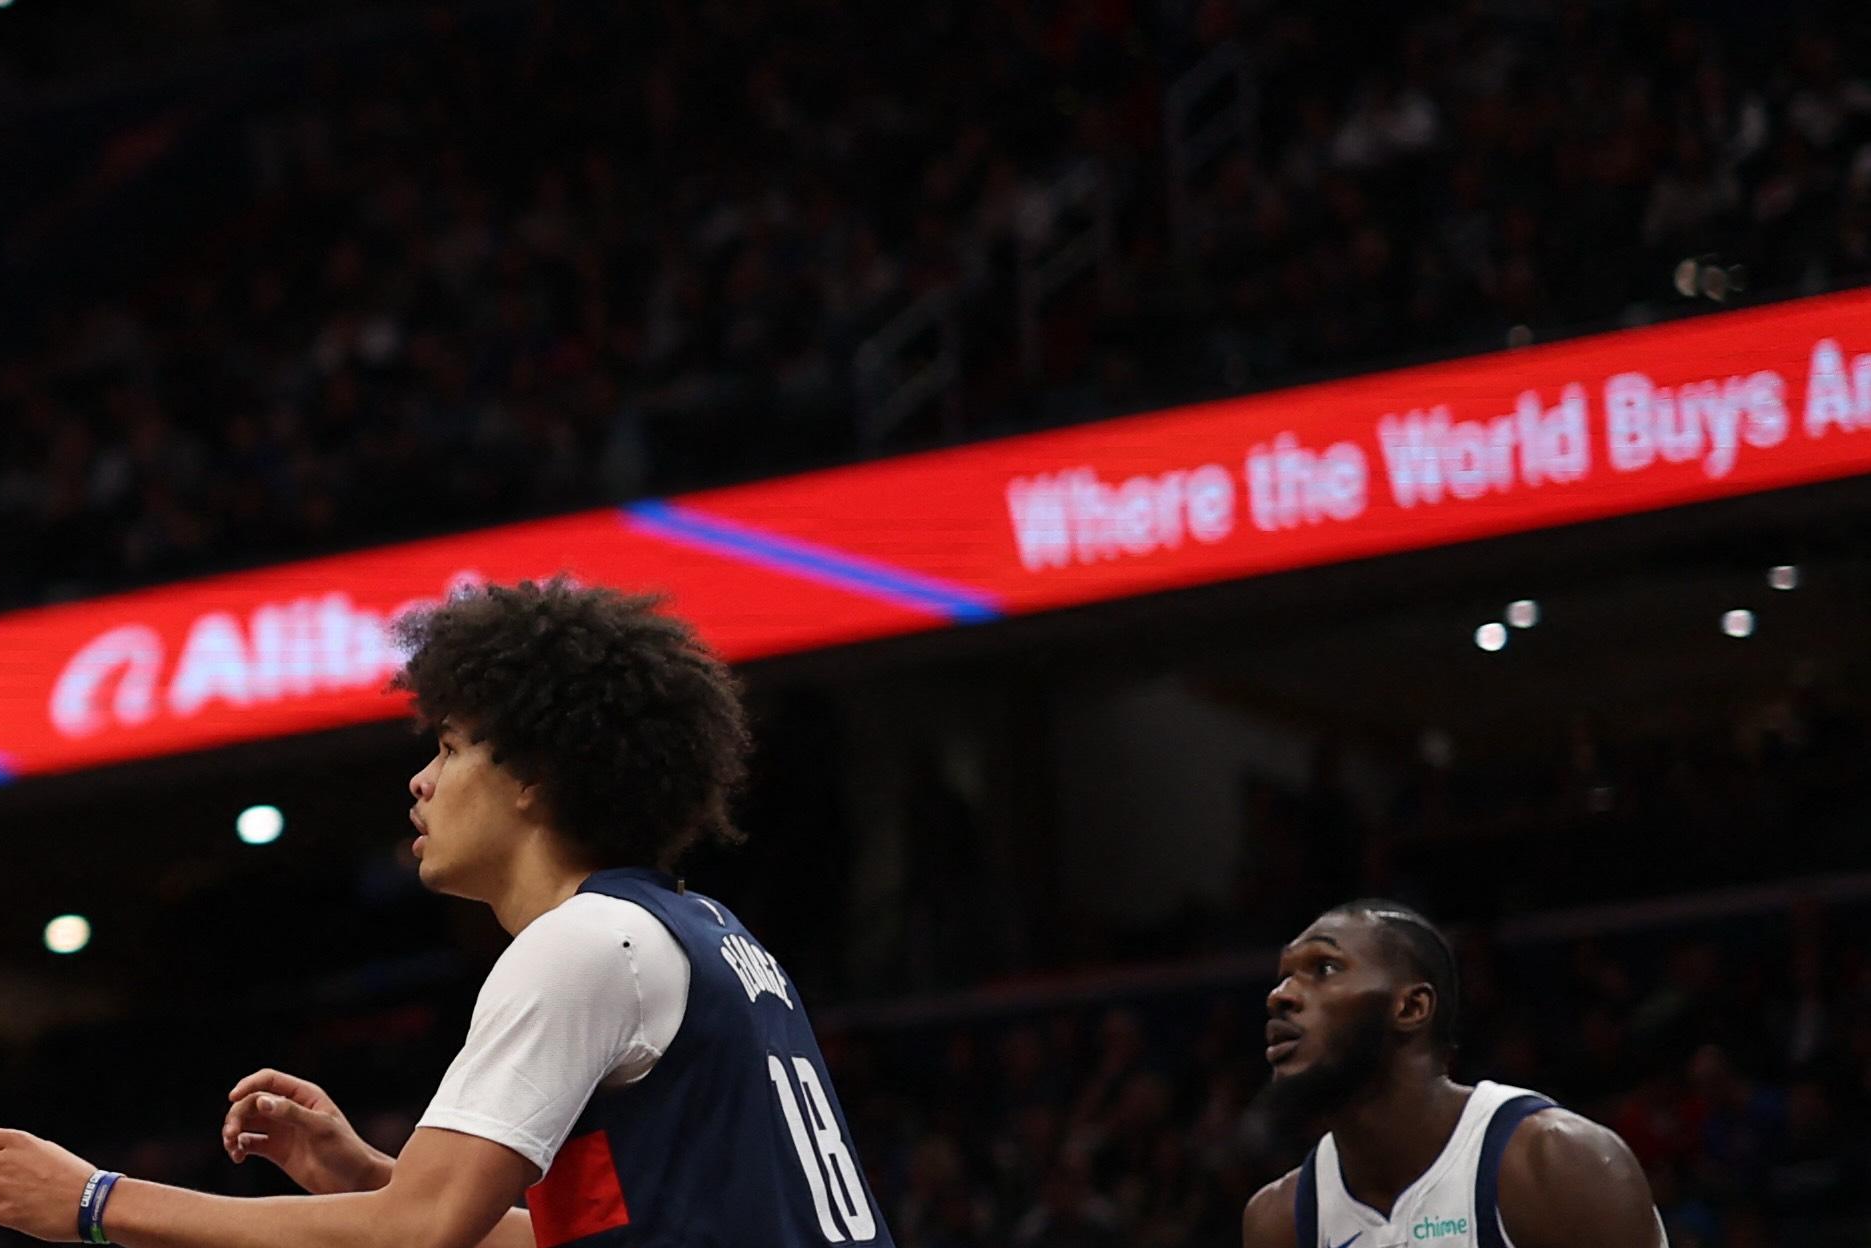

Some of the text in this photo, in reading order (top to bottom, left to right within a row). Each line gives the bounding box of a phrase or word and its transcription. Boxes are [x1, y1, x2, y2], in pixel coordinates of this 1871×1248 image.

[1008, 337, 1871, 572] Where the World Buys A
[767, 1054, 877, 1243] 18
[1413, 1215, 1468, 1241] chime
